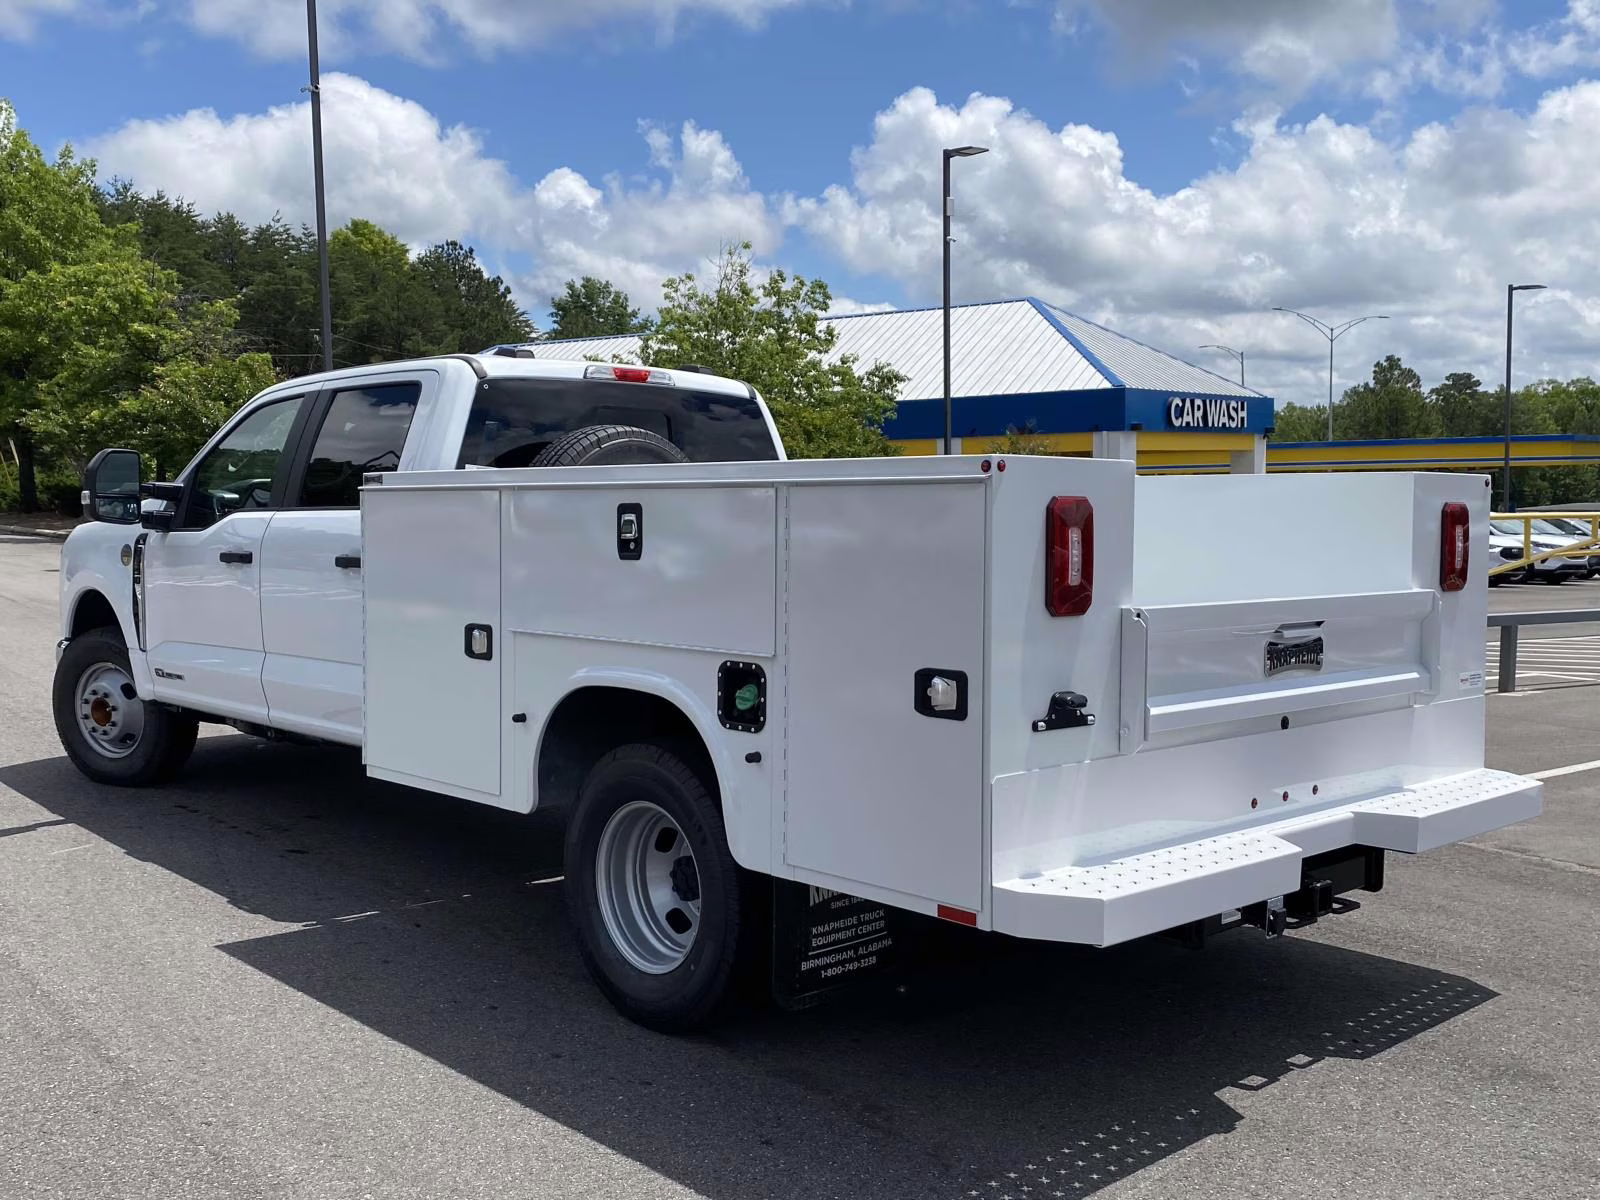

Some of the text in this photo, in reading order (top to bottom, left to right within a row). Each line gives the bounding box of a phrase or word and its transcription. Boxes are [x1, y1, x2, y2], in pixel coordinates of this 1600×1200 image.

[1170, 397, 1248, 428] CAR WASH
[830, 899, 850, 909] SINCE
[811, 920, 885, 946] EQUIPMENT CENTER
[812, 908, 885, 935] KNAPHEIDE TRUCK
[801, 937, 893, 971] BIRMINGHAM, ALABAMA
